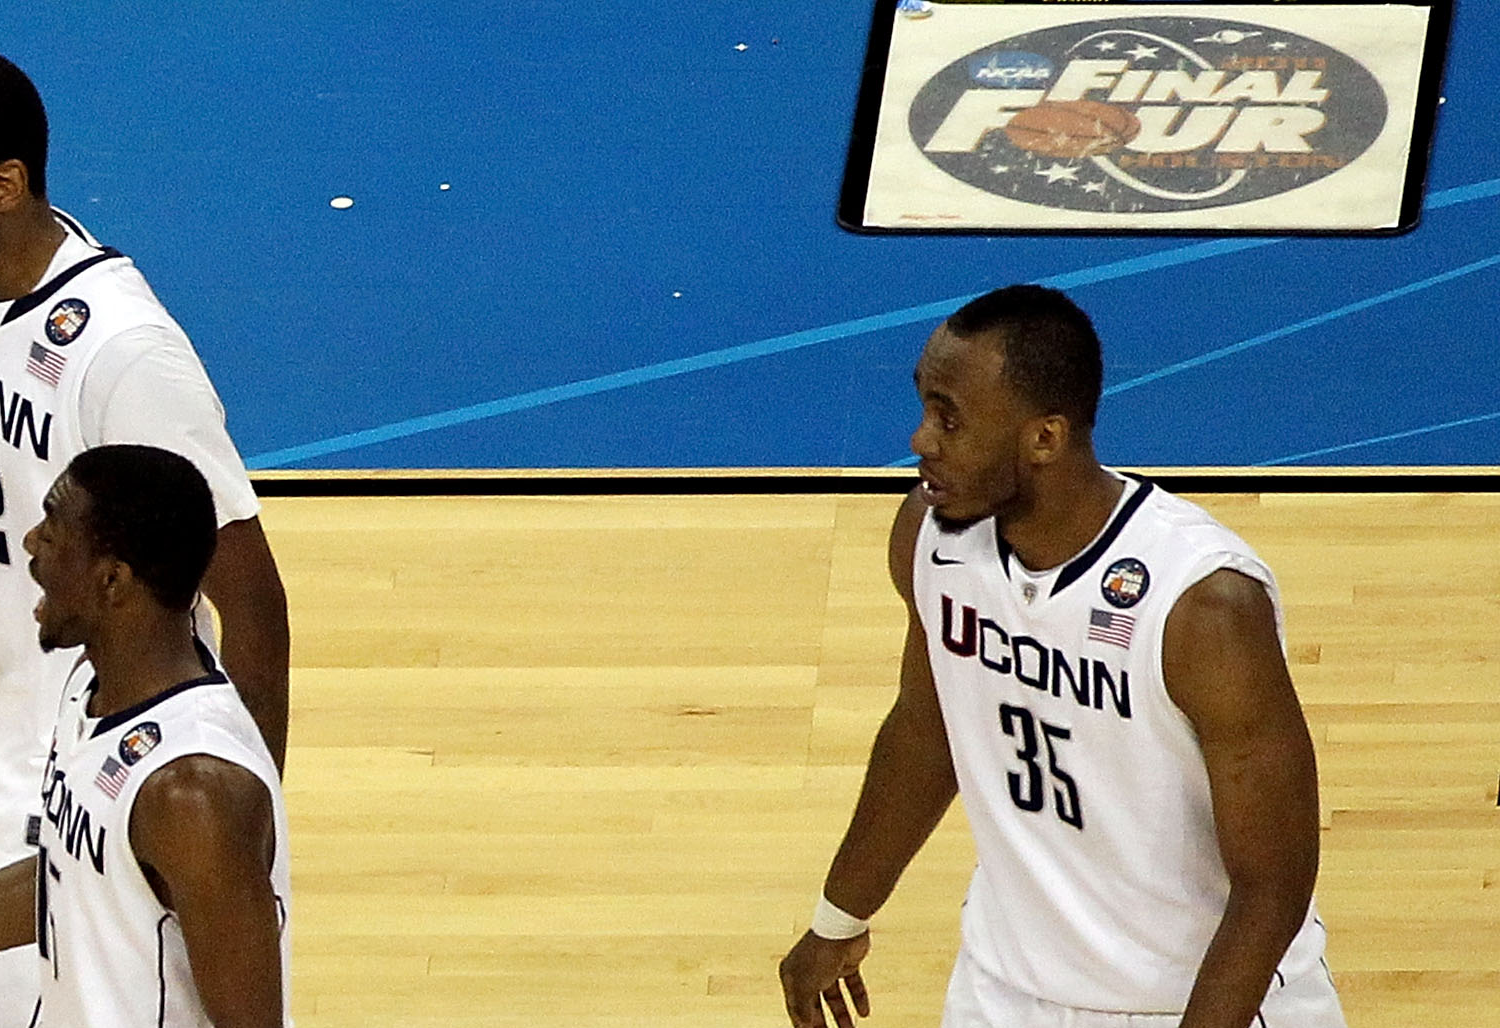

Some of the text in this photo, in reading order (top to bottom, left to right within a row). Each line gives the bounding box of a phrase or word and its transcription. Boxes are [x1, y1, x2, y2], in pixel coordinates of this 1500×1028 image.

[976, 67, 1050, 79] NCAA
[1044, 59, 1332, 103] FINAL
[941, 594, 1132, 719] UCONN
[42, 740, 106, 875] ONN
[1000, 703, 1084, 830] 35
